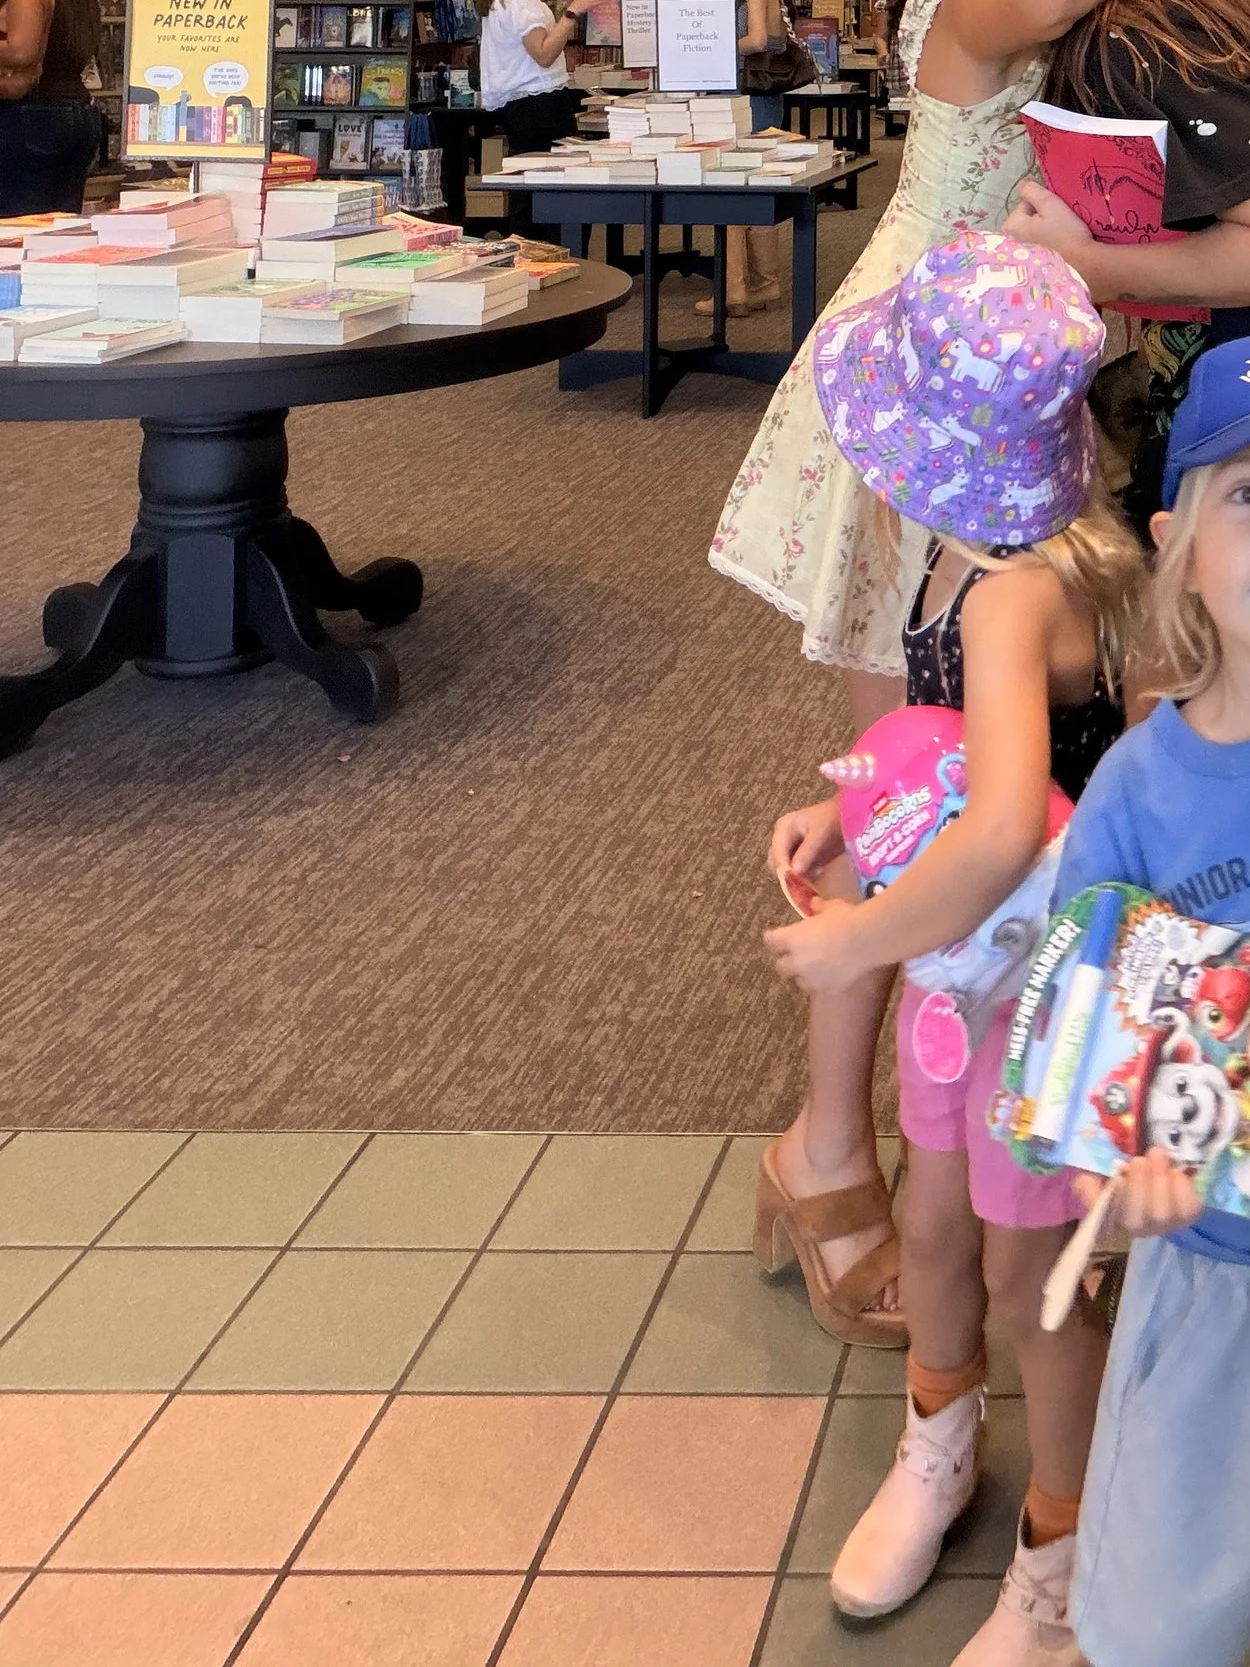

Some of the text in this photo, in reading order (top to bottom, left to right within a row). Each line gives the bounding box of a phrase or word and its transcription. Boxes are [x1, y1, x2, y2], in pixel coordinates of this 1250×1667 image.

[679, 9, 714, 17] The Best
[153, 14, 249, 29] PAPERBACK
[676, 33, 718, 42] Paperback
[683, 44, 712, 52] Fiction
